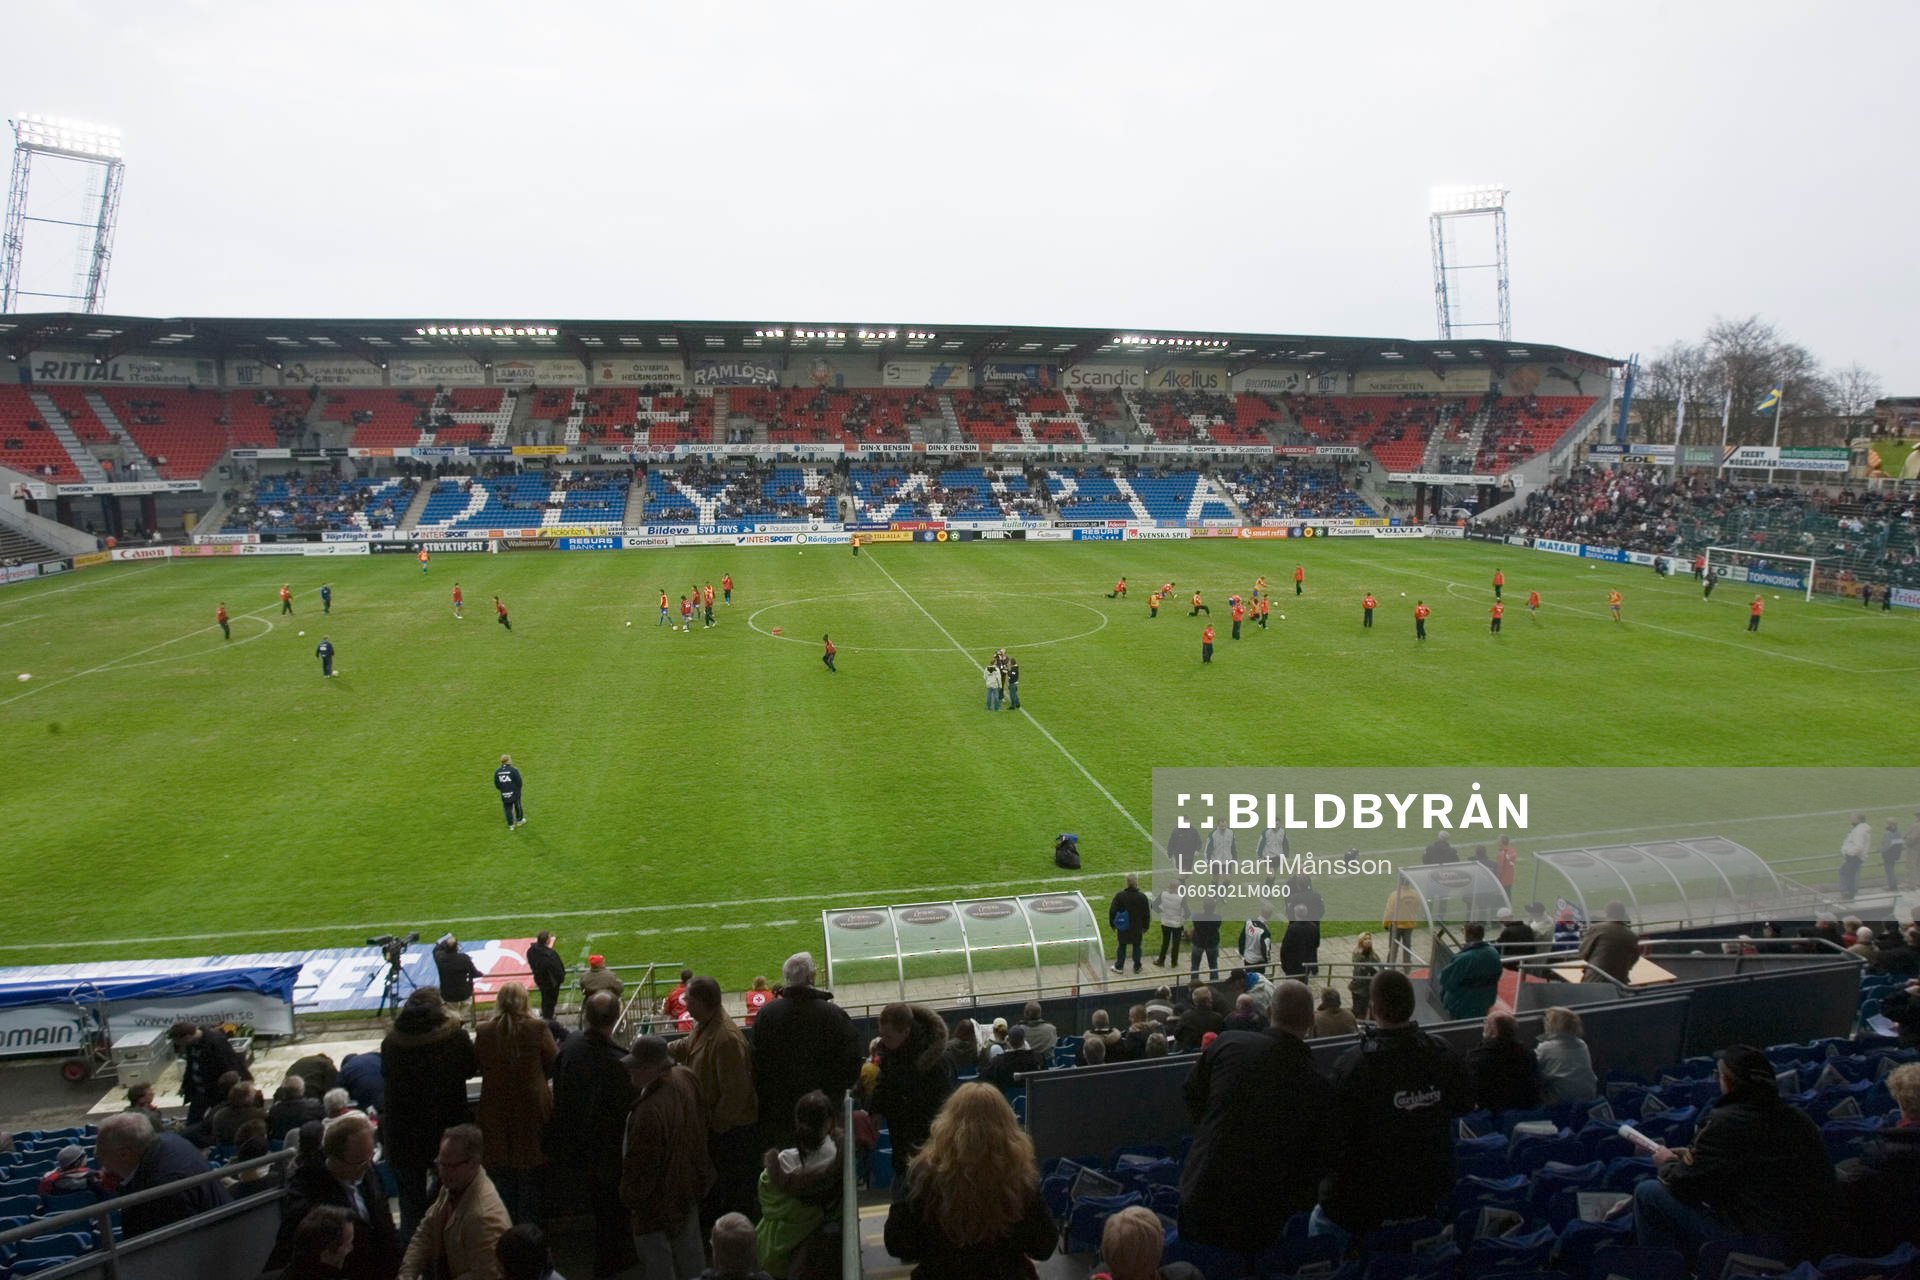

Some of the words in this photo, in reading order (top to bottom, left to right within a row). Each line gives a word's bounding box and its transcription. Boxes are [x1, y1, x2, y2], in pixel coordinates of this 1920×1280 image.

[36, 361, 123, 382] RITTAL
[418, 364, 481, 376] nicorette
[694, 361, 778, 385] RAMLÖSA
[1070, 369, 1139, 386] Scandic
[1158, 370, 1218, 389] Akelius
[690, 444, 723, 452] ARMATUR
[1779, 459, 1845, 470] Handelsbanken
[647, 526, 689, 535] Bildeve
[698, 525, 715, 534] SYD
[717, 525, 738, 534] FRYS
[1000, 521, 1047, 530] kullaflyg.se
[980, 530, 1003, 539] PUMA
[1252, 528, 1271, 537] smart
[568, 537, 613, 545] RESURS
[746, 535, 793, 543] INTERSPORT
[423, 542, 484, 552] STRYKTIPSET
[1537, 541, 1577, 554] MATAKI
[119, 549, 166, 559] Canon
[1749, 571, 1800, 588] TOPNORDIC
[134, 1008, 255, 1028] www.biomain.se
[1393, 1086, 1440, 1107] Carlsberg
